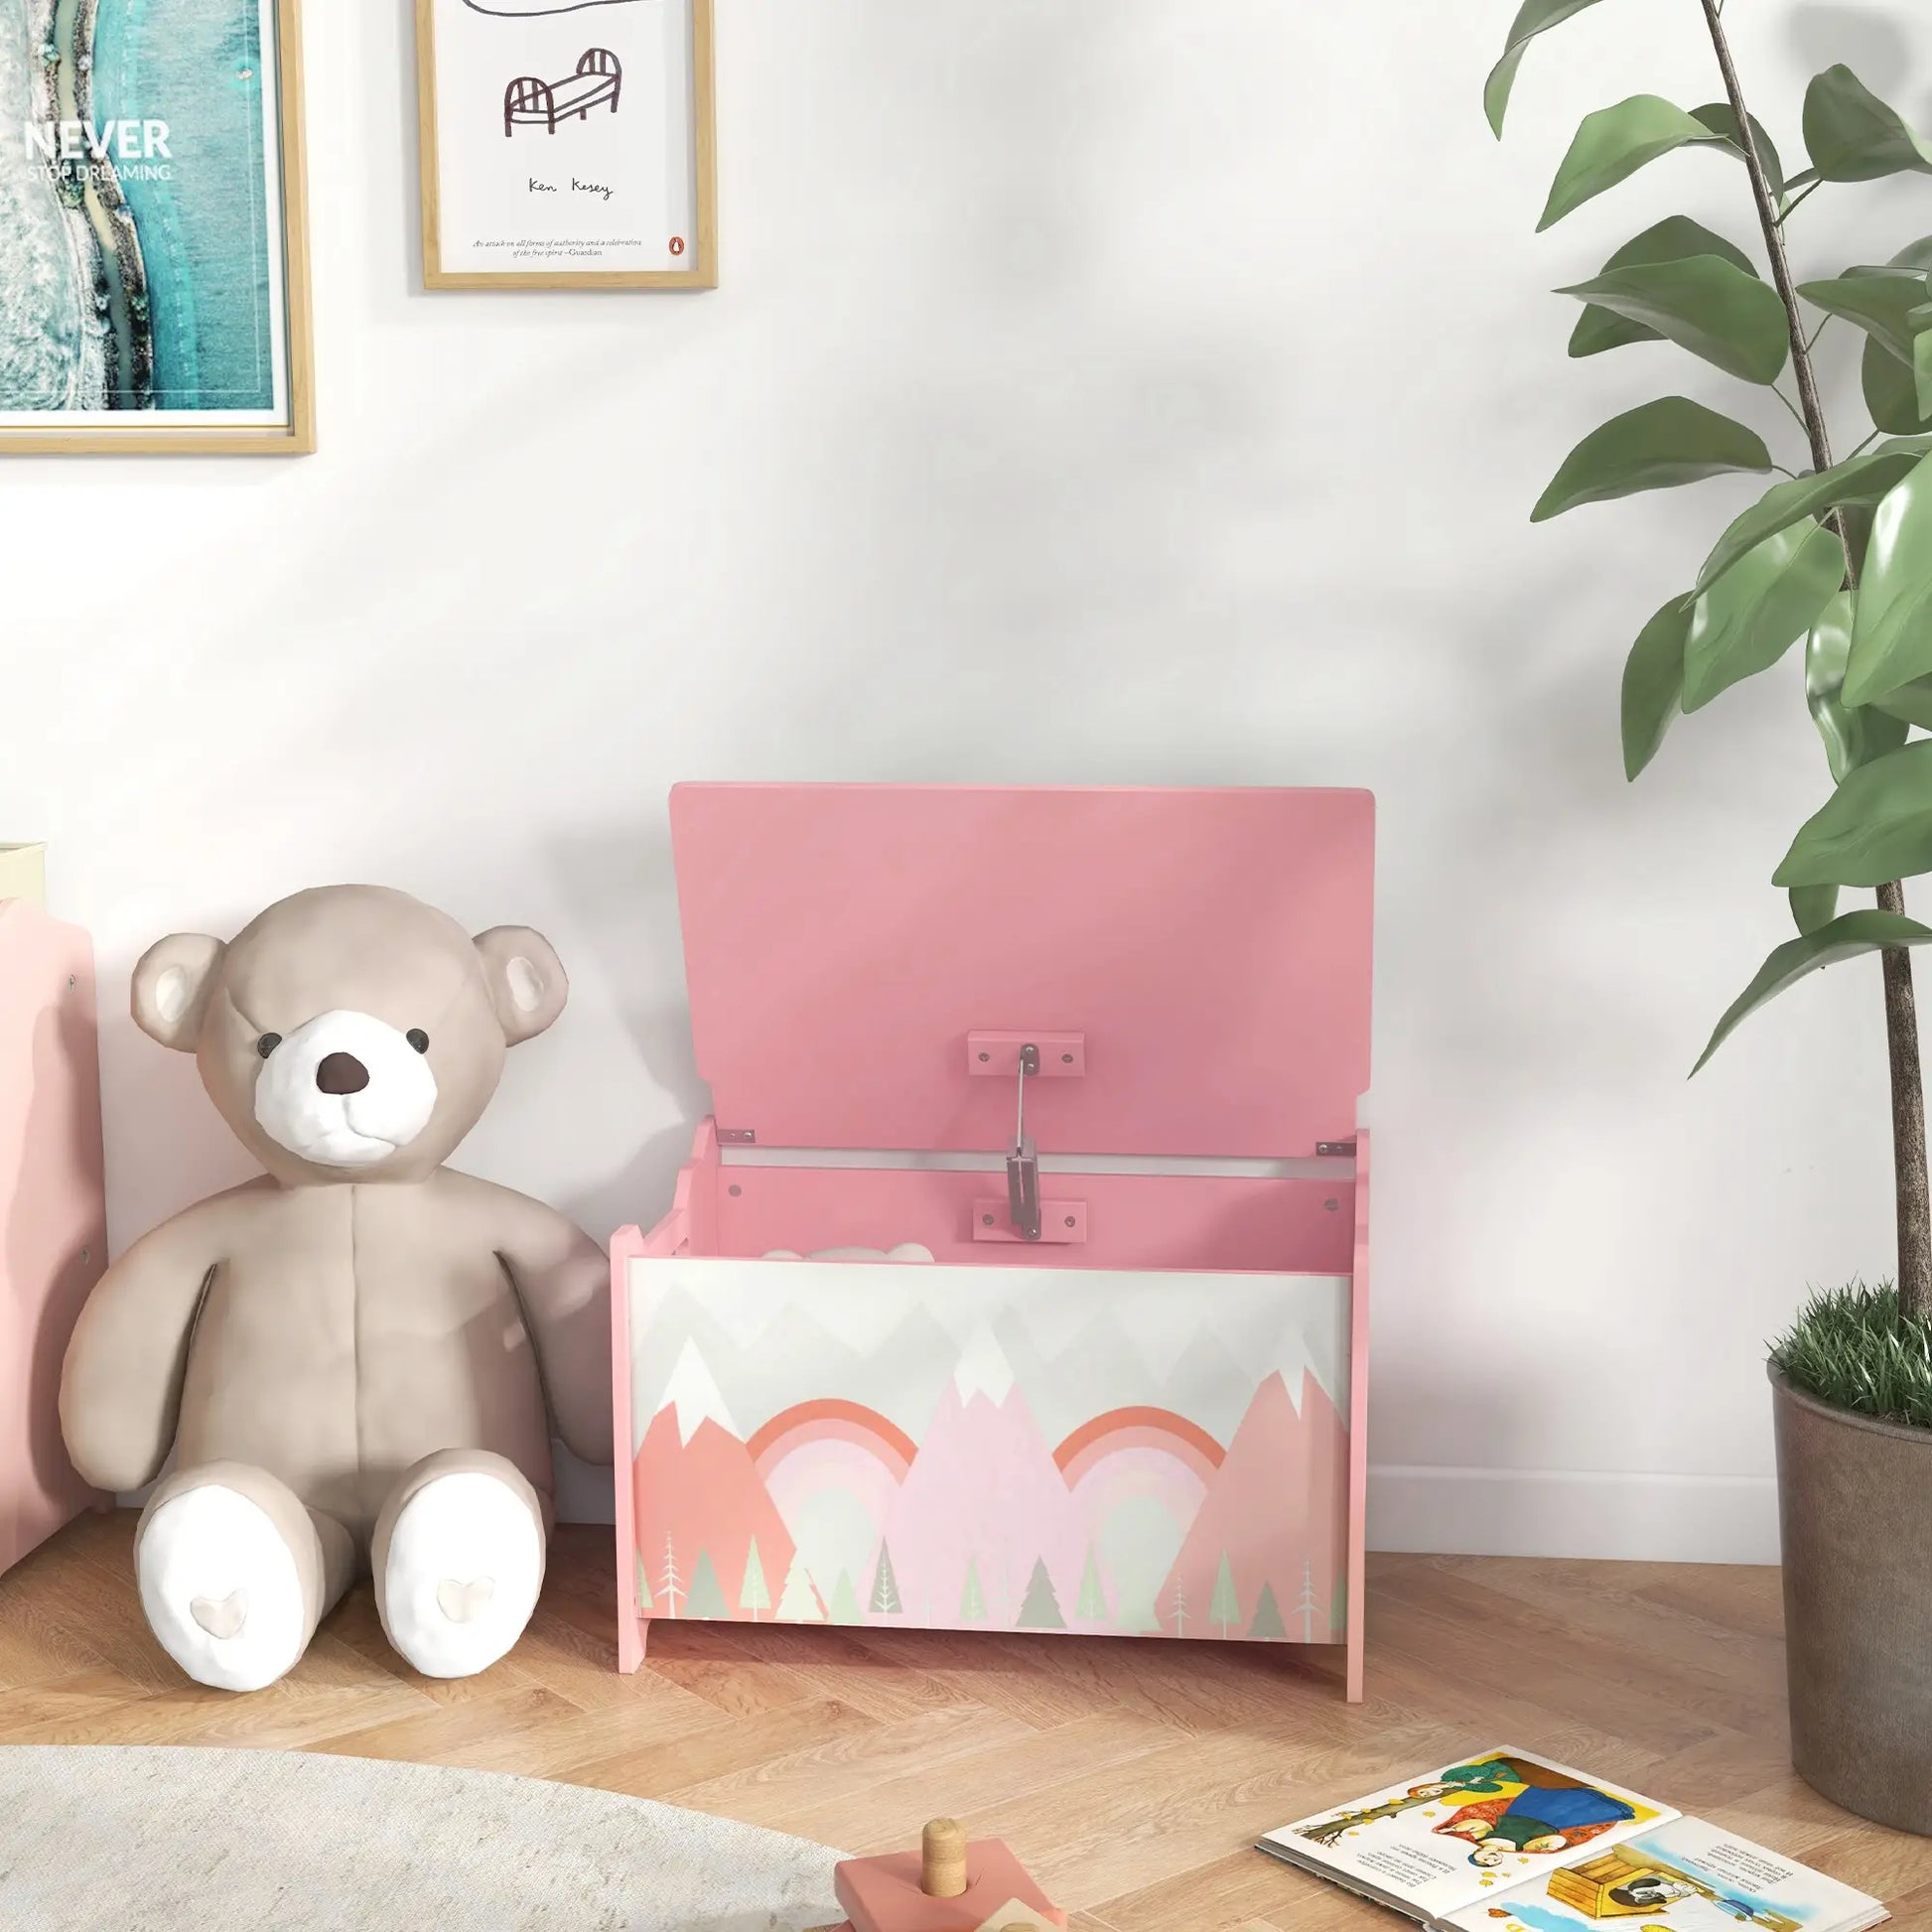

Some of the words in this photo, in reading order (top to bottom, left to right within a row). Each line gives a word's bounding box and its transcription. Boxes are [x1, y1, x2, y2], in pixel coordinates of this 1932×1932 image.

[25, 119, 172, 159] NEVER
[28, 165, 72, 182] STOP
[529, 177, 557, 193] Ken
[572, 177, 614, 202] Kesey
